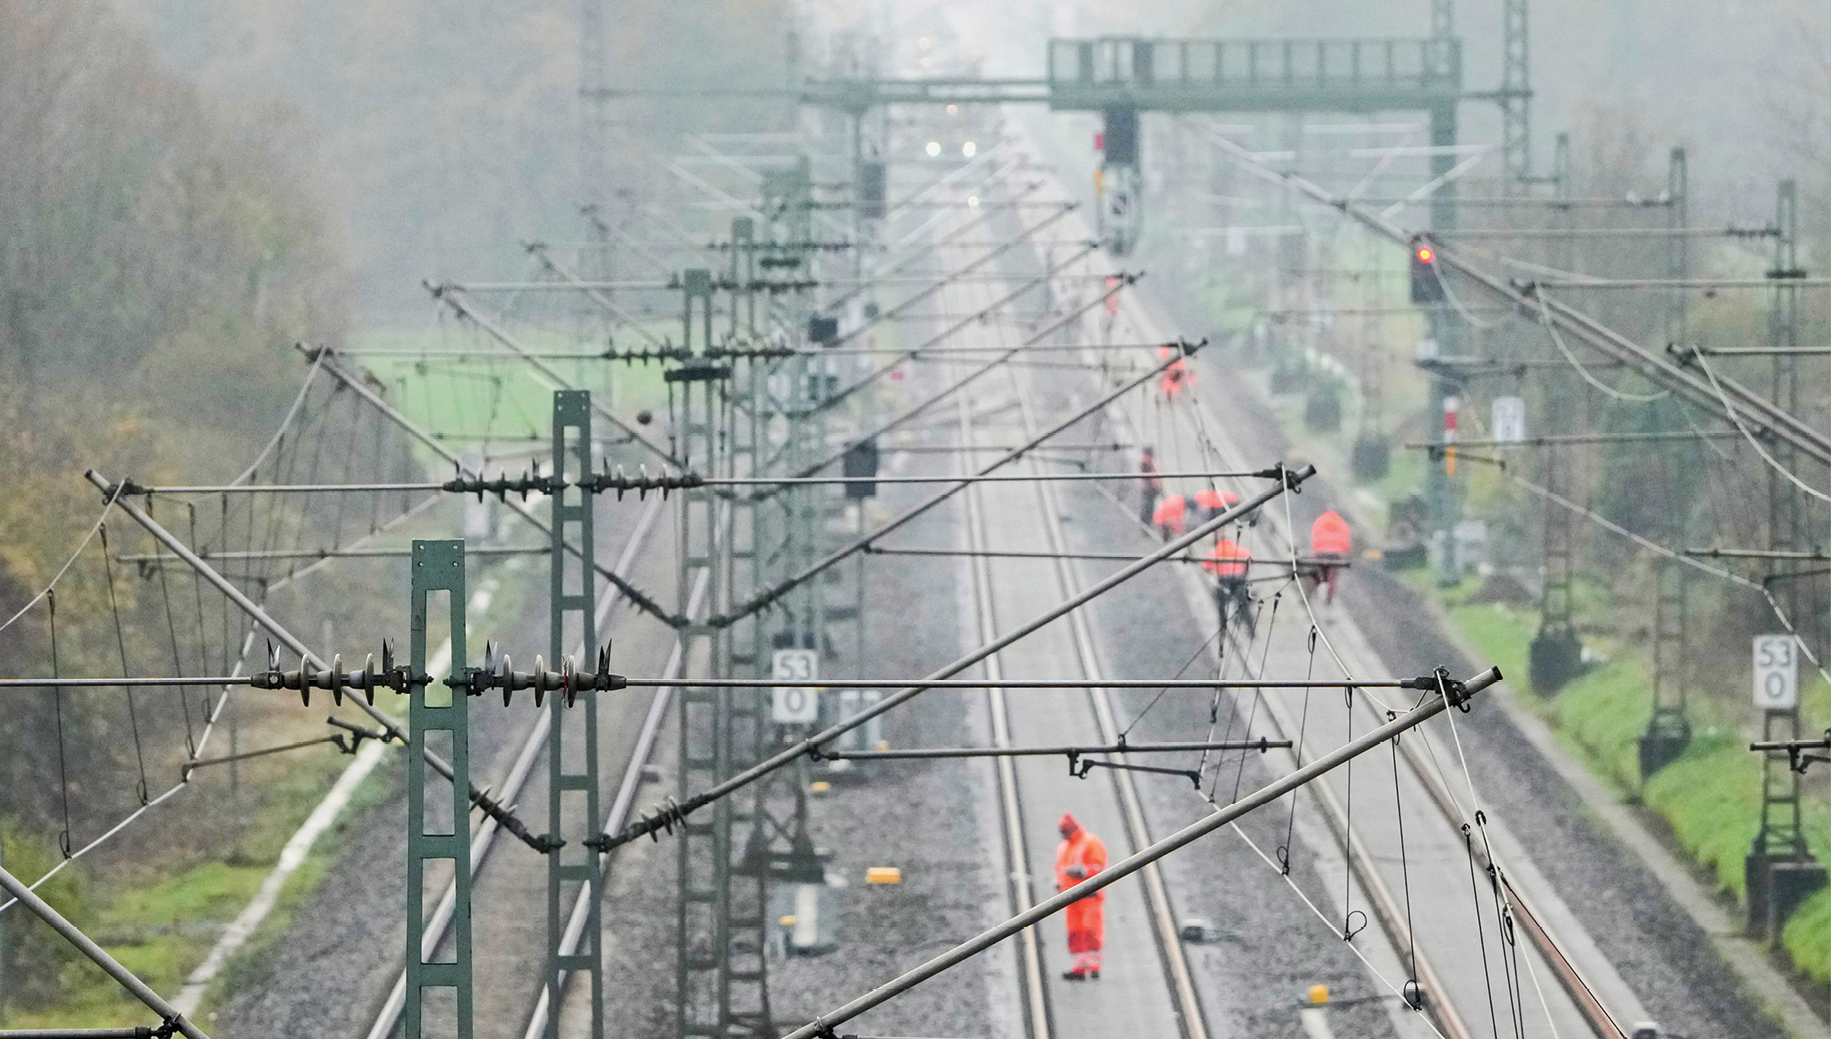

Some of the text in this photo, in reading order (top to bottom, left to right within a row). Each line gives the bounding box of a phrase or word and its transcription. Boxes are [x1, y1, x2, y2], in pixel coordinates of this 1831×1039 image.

[779, 655, 812, 680] 53
[1760, 640, 1791, 668] 53
[1764, 671, 1786, 699] 0
[784, 687, 807, 714] 0
